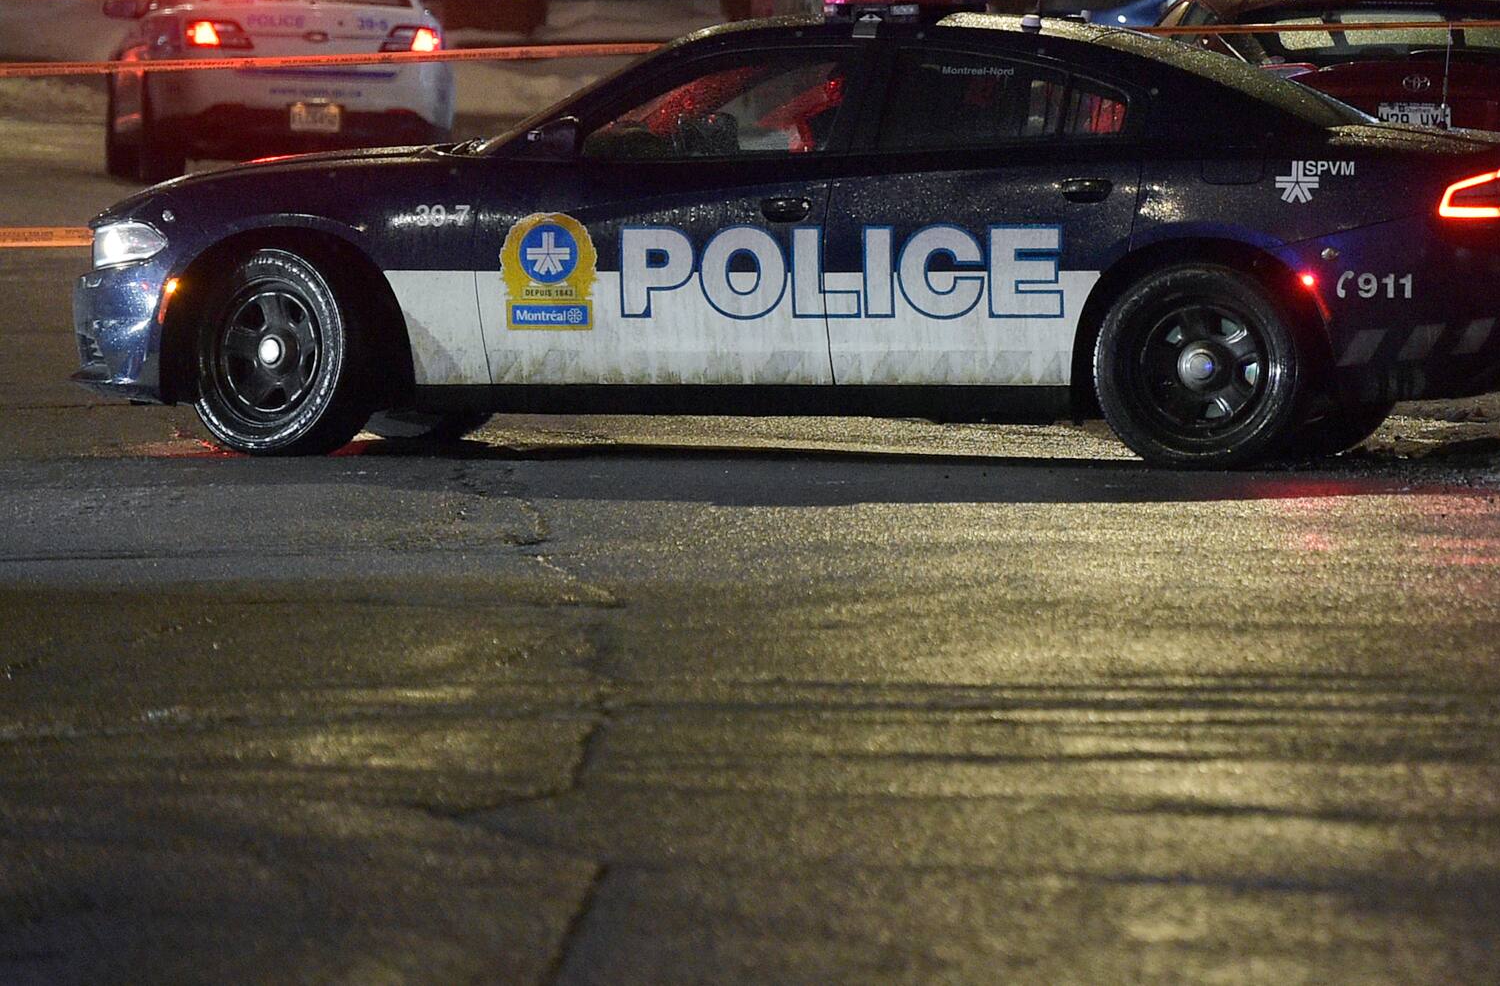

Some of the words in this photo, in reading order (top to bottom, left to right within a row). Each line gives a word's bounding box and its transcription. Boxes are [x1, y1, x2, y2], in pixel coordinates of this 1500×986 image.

[1305, 160, 1355, 176] SPVM
[415, 204, 471, 228] 39-7
[619, 224, 1065, 320] POLICE
[525, 288, 552, 297] DEPUIS
[1357, 272, 1413, 299] 911
[516, 309, 567, 322] Montréal
